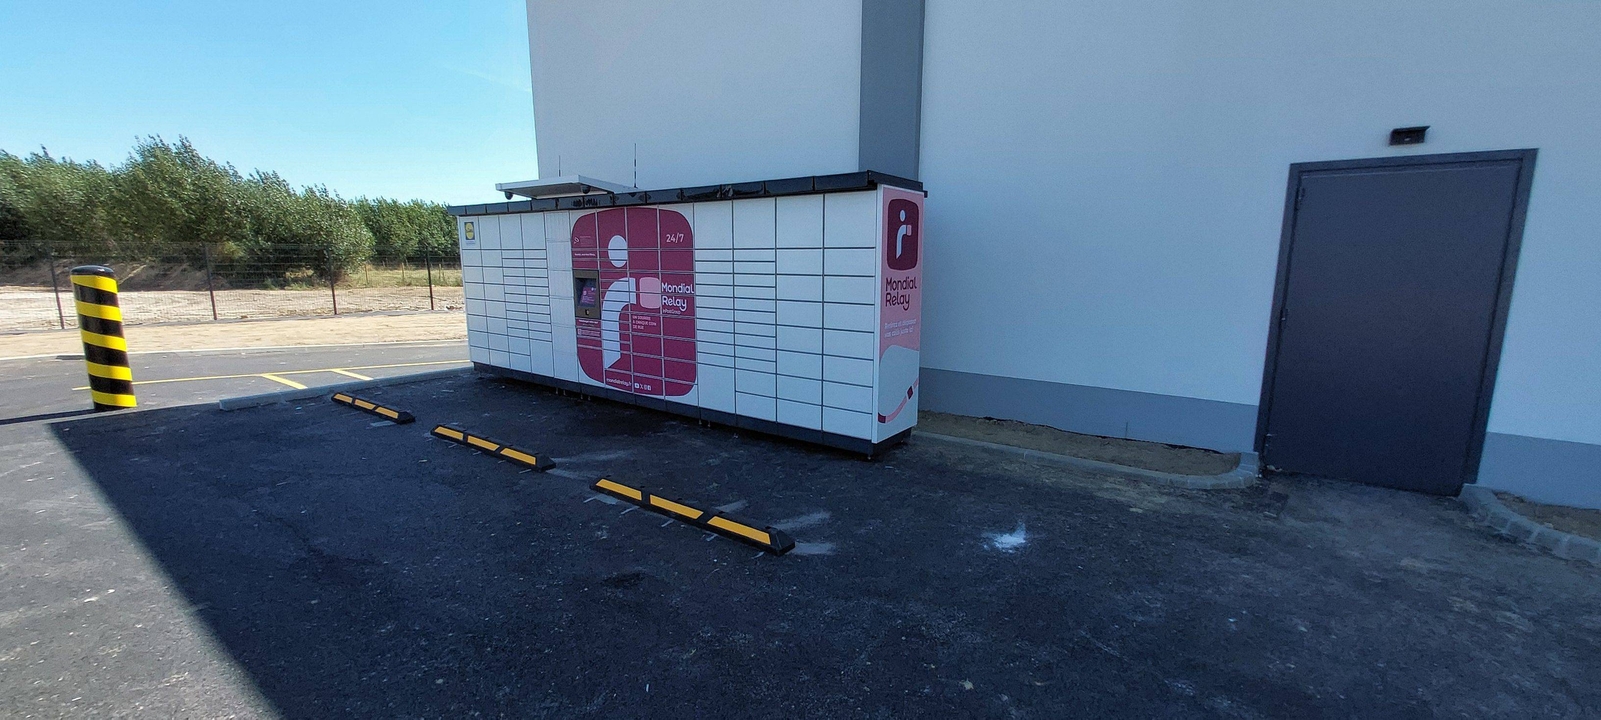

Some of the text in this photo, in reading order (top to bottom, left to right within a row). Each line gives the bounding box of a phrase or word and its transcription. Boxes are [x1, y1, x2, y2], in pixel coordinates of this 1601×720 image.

[666, 232, 684, 243] 24/7
[661, 282, 695, 294] Mondial
[885, 276, 917, 291] Mondial
[662, 295, 687, 312] Relay
[885, 291, 910, 311] Relay
